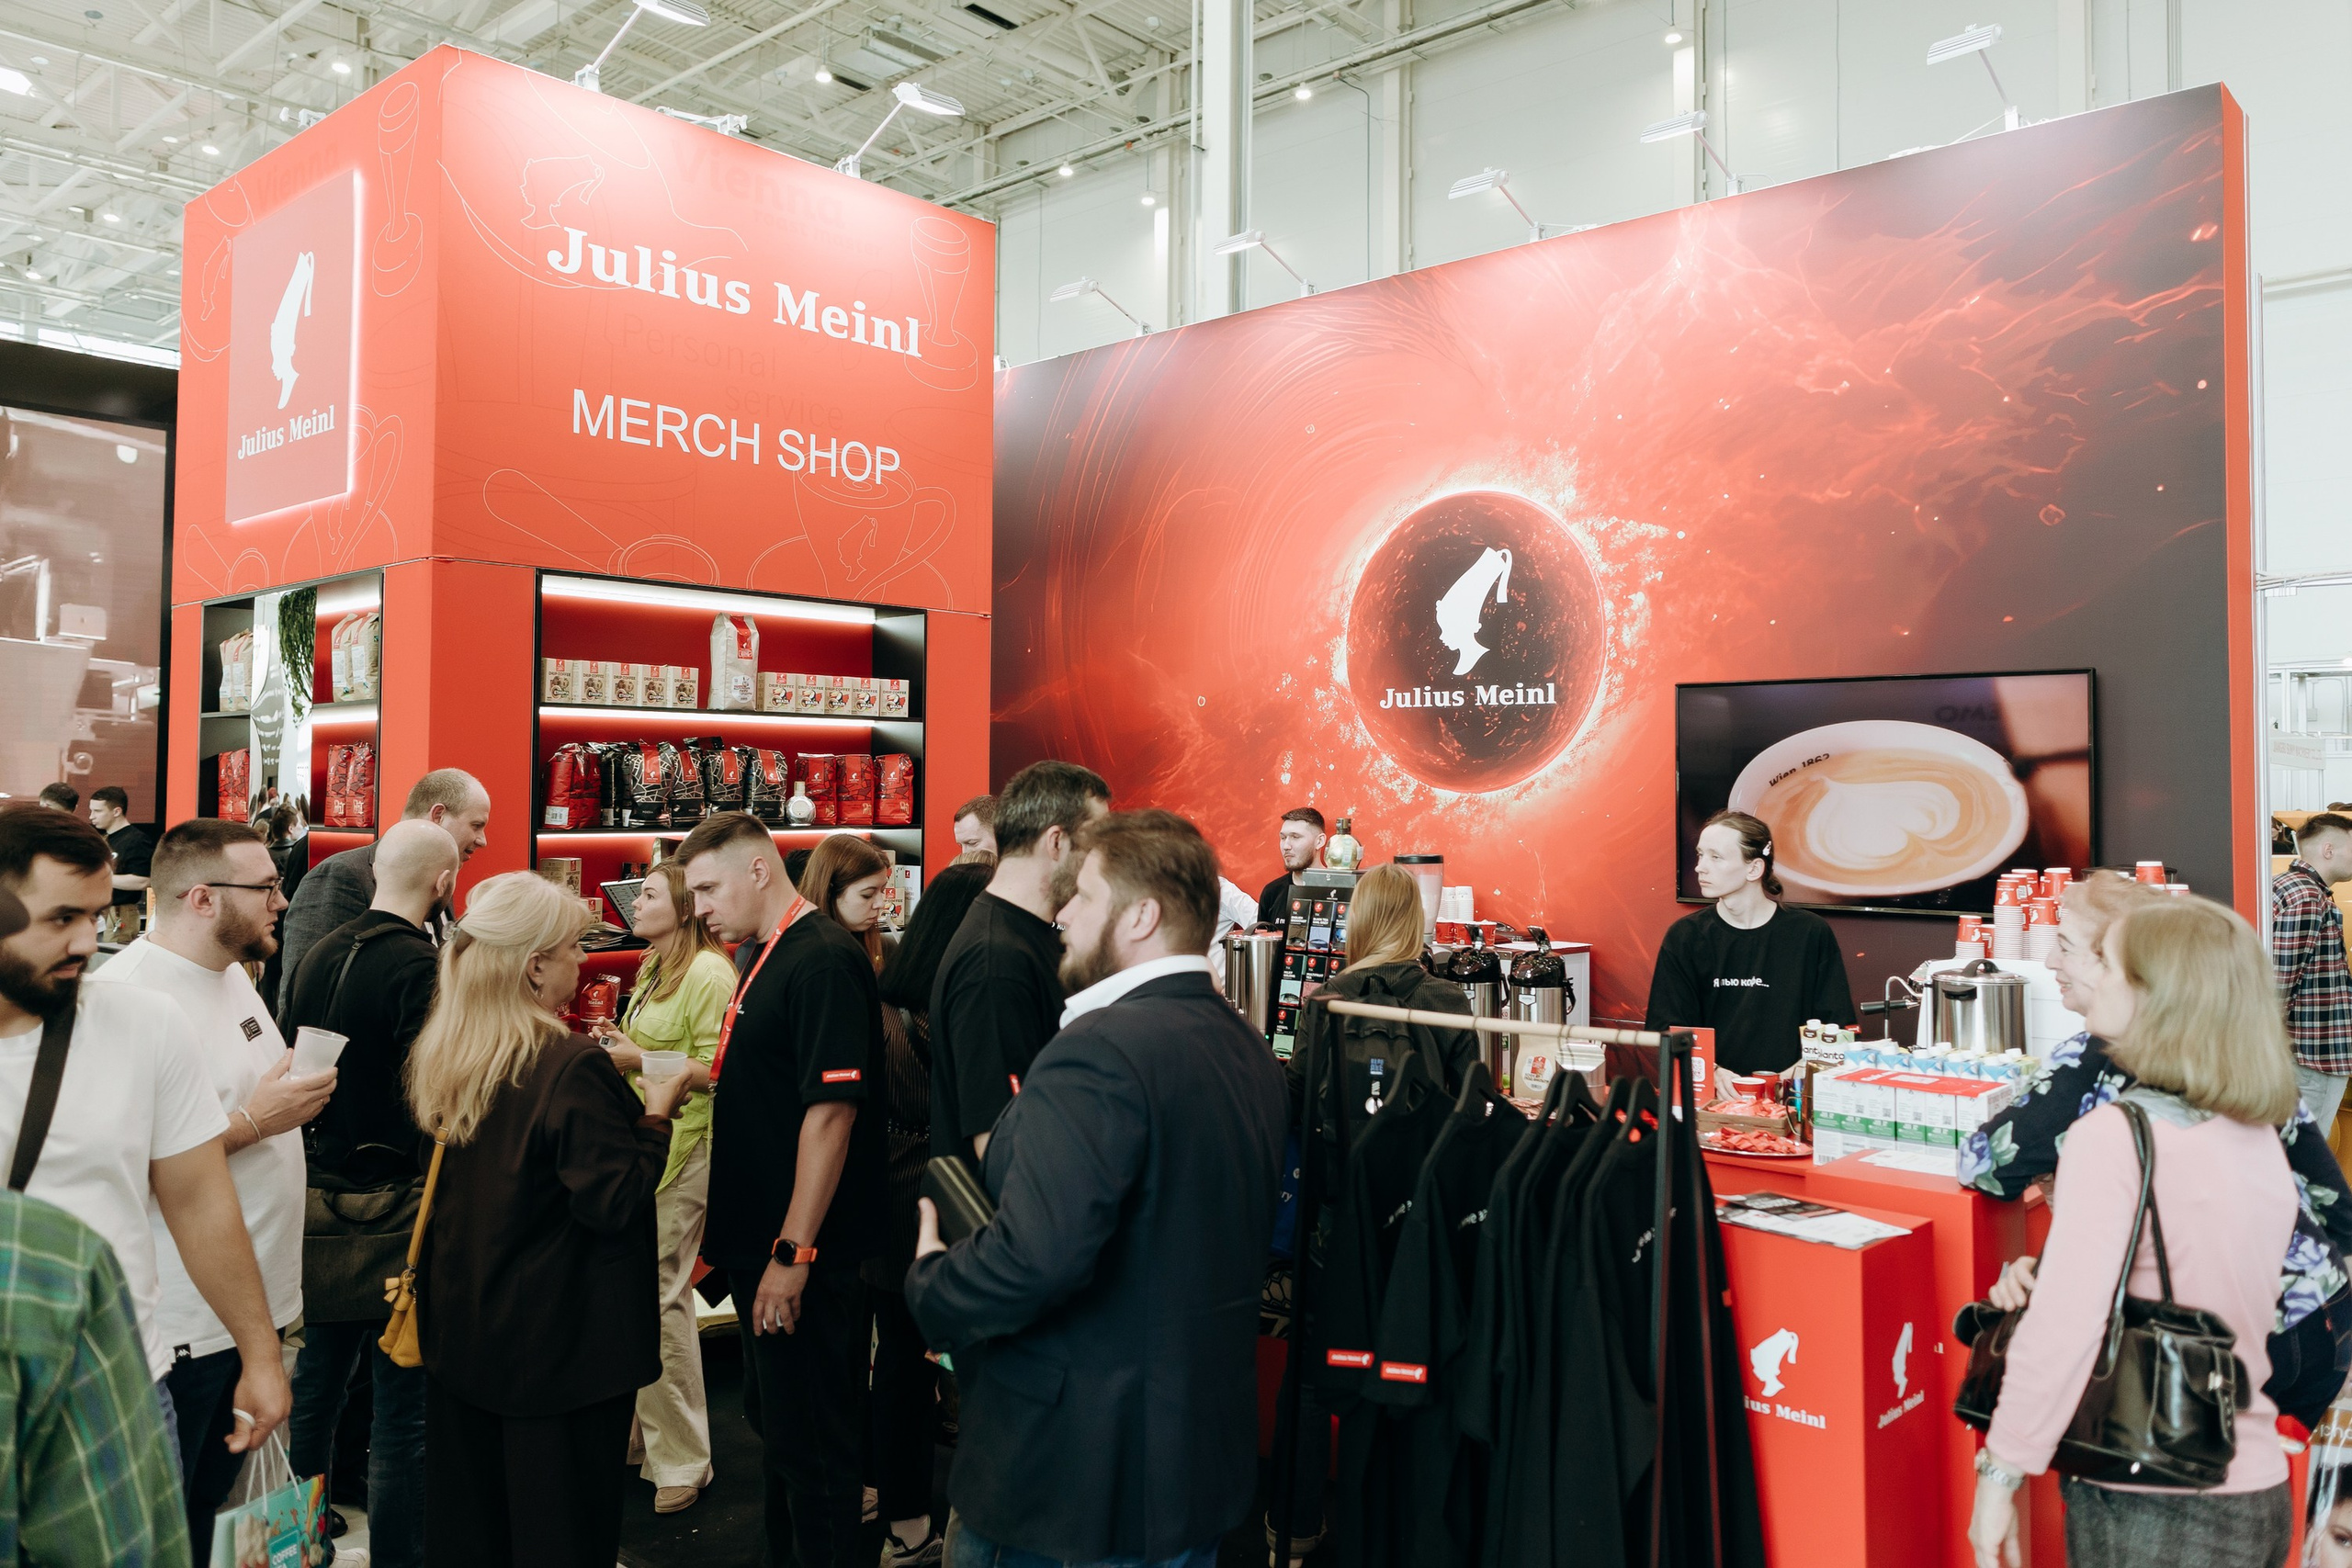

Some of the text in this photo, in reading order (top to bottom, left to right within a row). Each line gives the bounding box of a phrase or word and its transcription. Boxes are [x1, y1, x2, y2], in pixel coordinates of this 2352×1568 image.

[547, 226, 922, 359] Julius Meinl
[237, 403, 336, 461] Julius Meinl
[572, 389, 900, 486] MERCH SHOP
[1379, 682, 1557, 709] Julius Meinl
[1713, 977, 1720, 987] Я
[1744, 1395, 1826, 1429] ius Meinl
[1877, 1389, 1925, 1430] Julius Meinl
[272, 1544, 298, 1565] COFFEE
